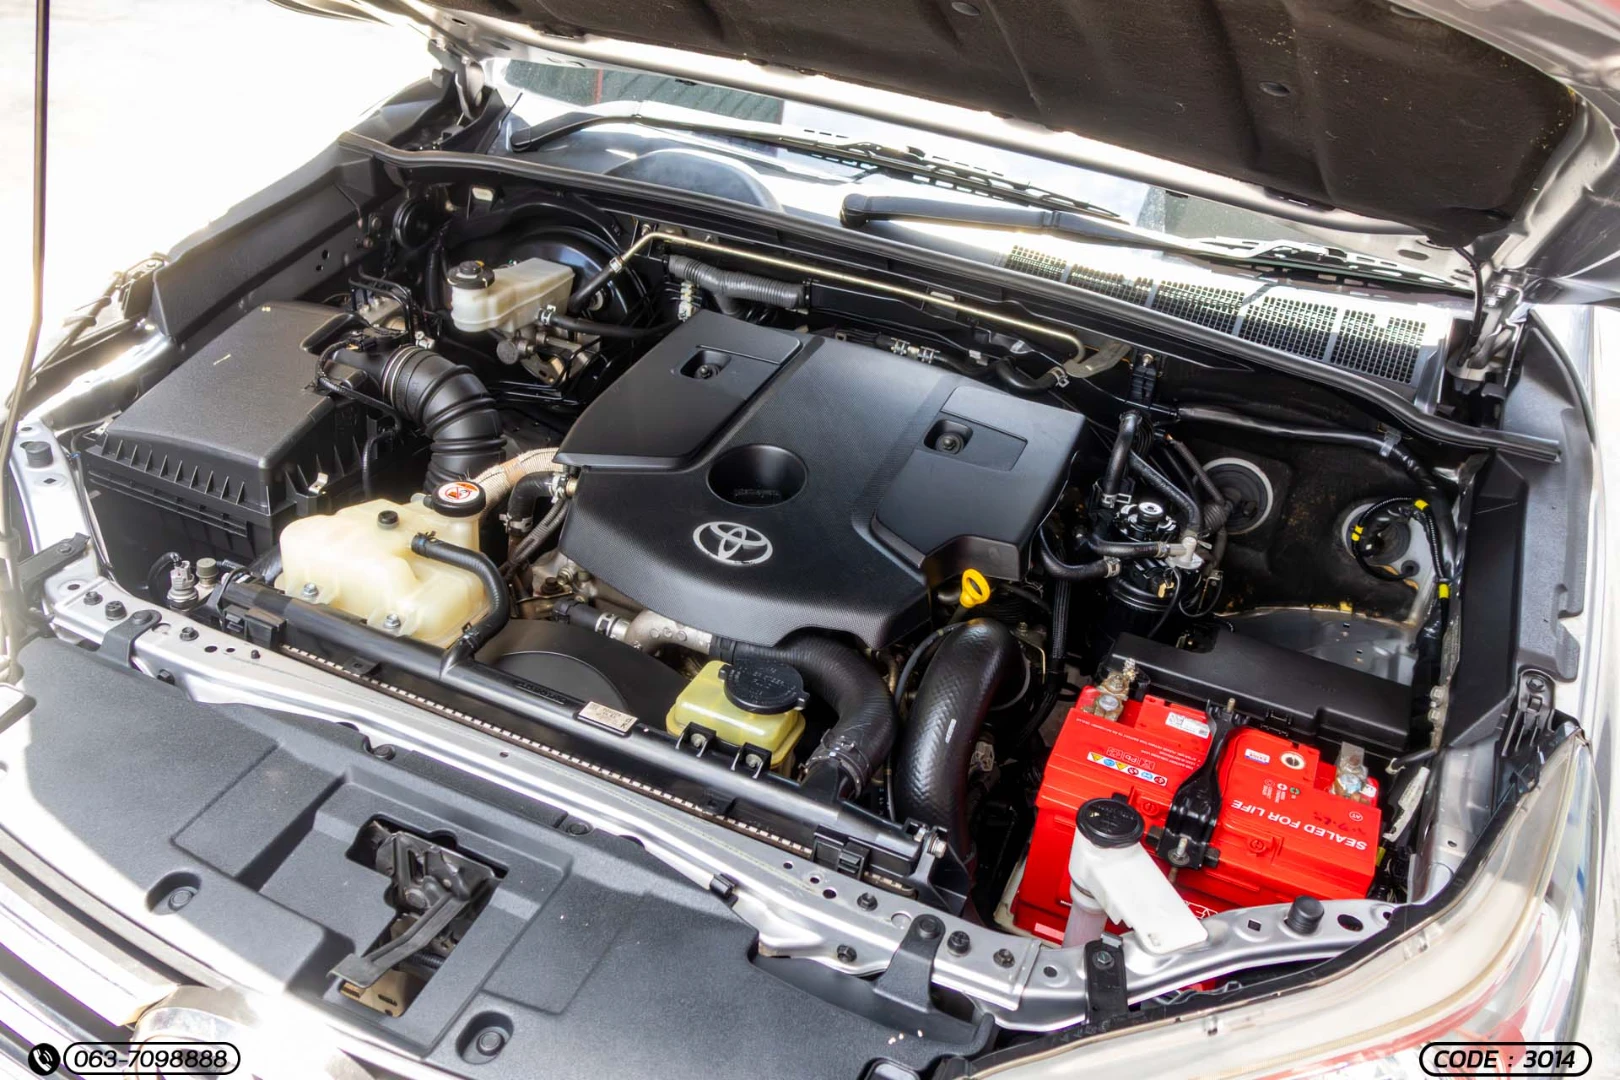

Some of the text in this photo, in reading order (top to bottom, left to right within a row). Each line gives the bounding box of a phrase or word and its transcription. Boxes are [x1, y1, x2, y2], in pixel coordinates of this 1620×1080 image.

[1231, 799, 1265, 817] LIFE
[1267, 811, 1301, 829] FOR
[1304, 825, 1368, 851] SEALED
